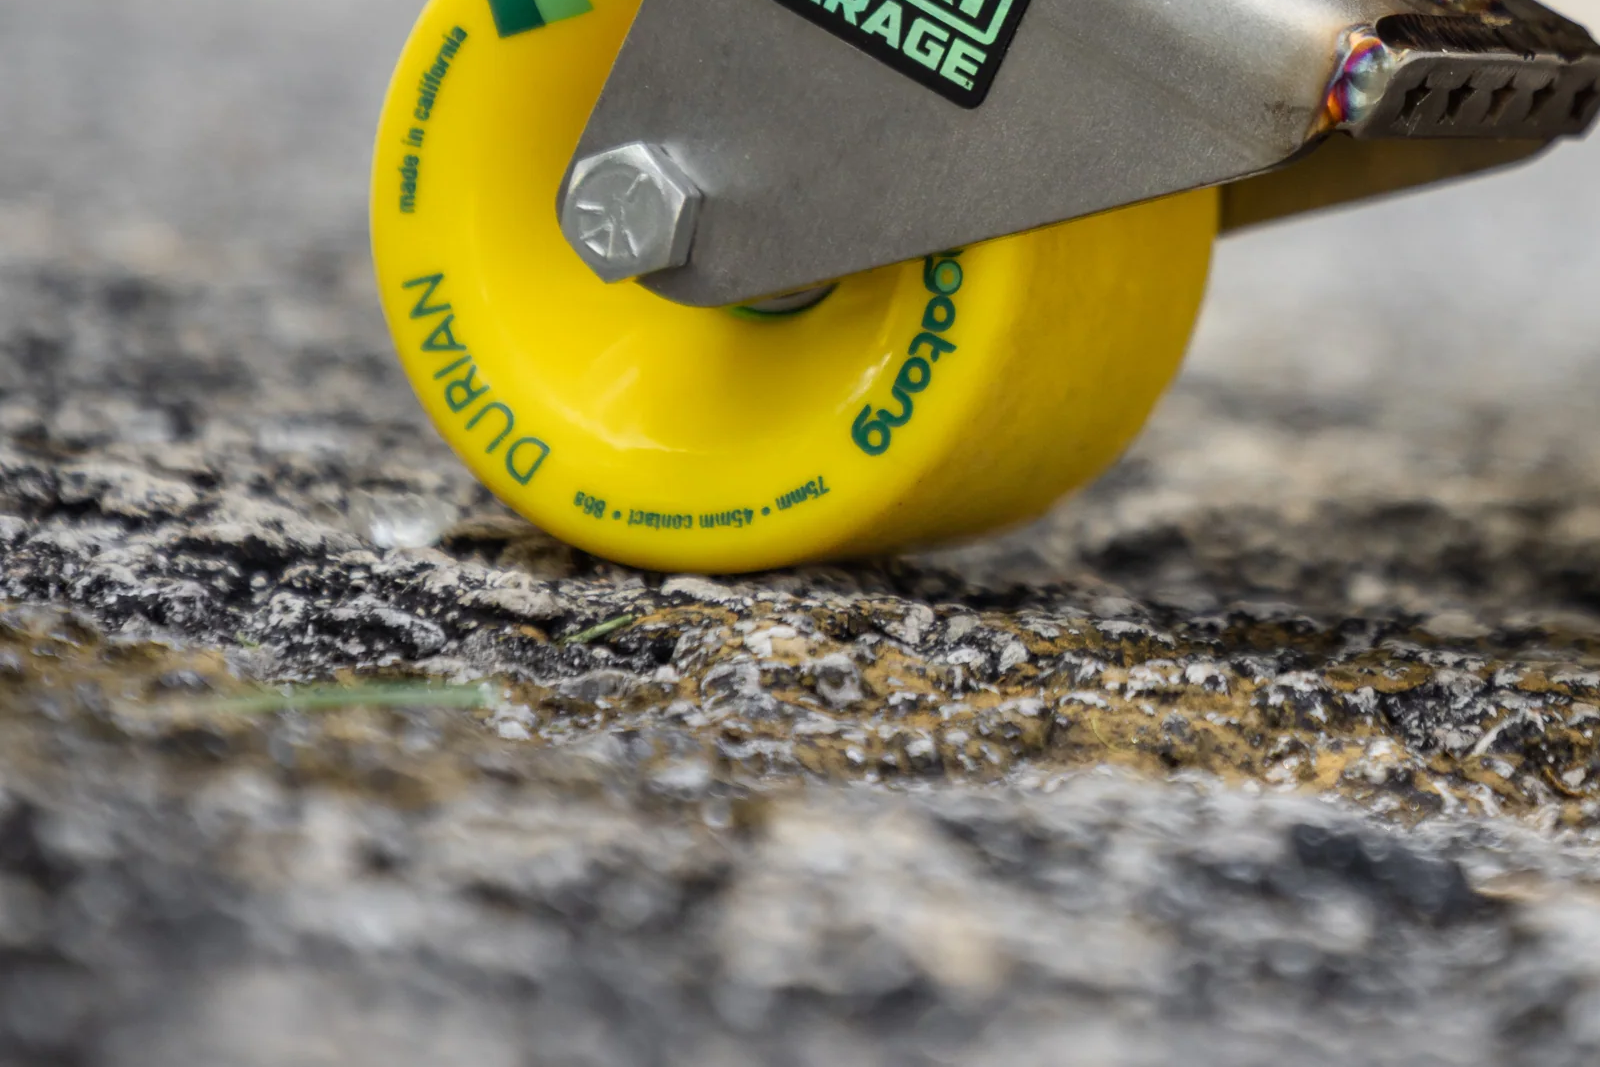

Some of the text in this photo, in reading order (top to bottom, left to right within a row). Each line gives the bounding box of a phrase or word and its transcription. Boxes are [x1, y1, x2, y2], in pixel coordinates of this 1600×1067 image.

[398, 25, 469, 214] made in california
[401, 272, 551, 486] DURIAN
[851, 250, 964, 457] gatang
[627, 508, 694, 530] contact
[699, 507, 755, 529] 45mm
[775, 475, 831, 511] 75mm
